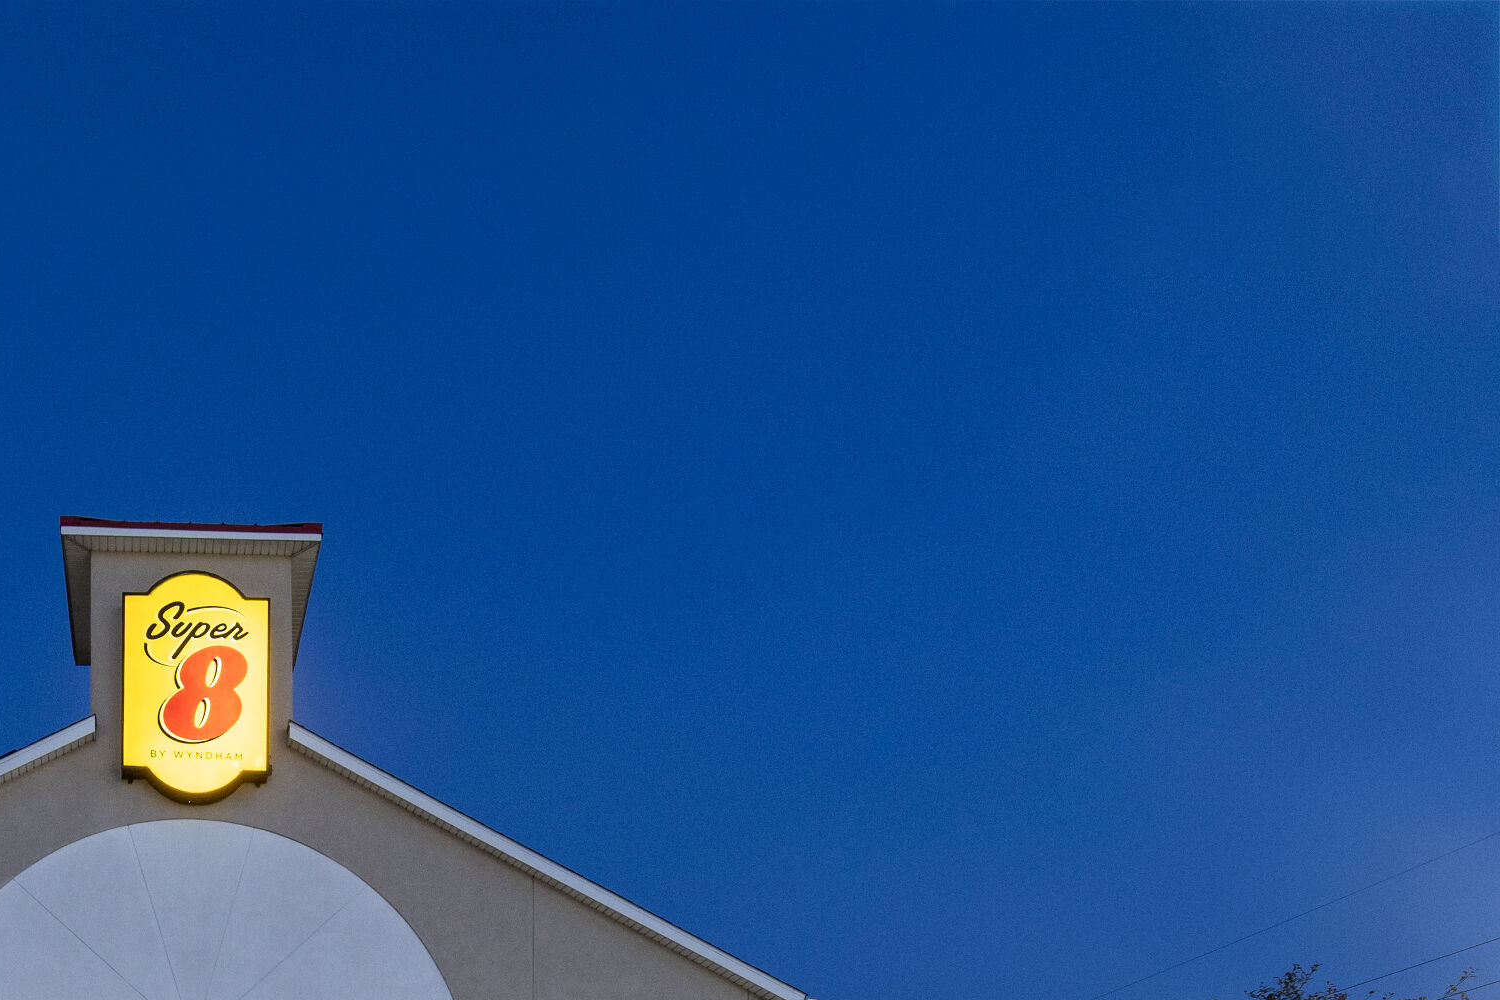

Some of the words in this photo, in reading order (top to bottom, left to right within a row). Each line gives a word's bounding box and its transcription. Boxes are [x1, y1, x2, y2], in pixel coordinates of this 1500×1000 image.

[146, 601, 249, 660] Super
[158, 645, 248, 744] 8
[150, 749, 166, 758] BY
[173, 751, 243, 761] WYNDHAM
